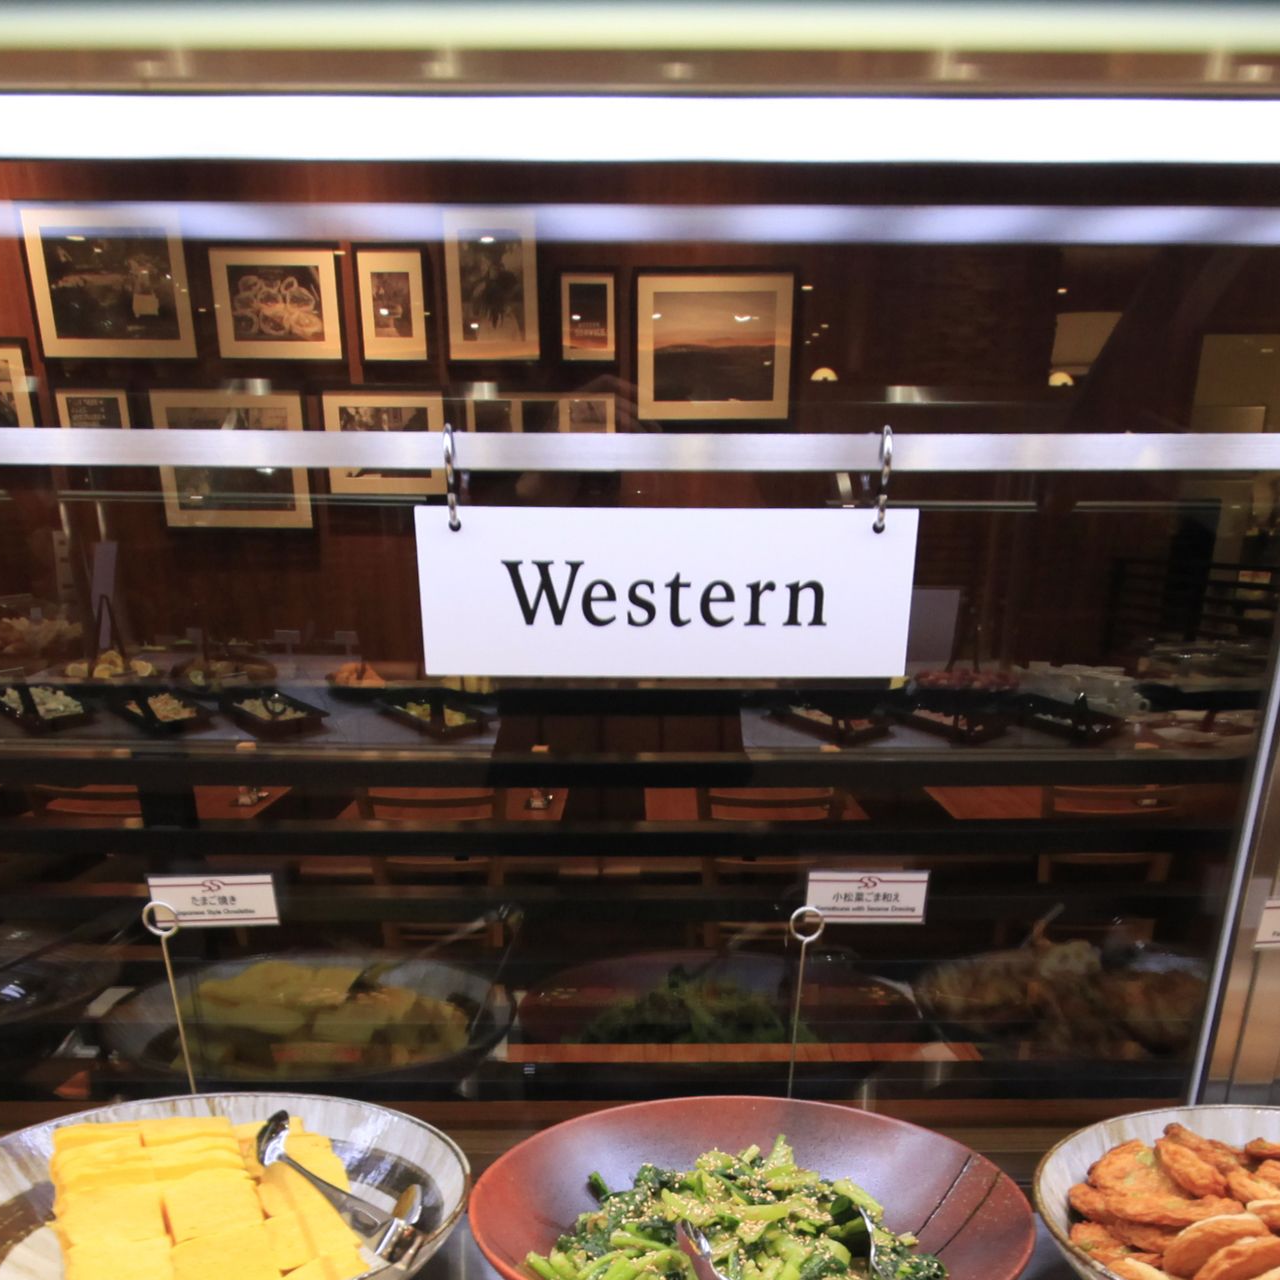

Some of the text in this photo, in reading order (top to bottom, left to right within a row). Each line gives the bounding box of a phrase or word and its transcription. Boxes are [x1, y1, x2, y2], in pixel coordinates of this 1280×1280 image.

[501, 560, 827, 628] Western
[832, 892, 900, 903] 小松菜ごま和え
